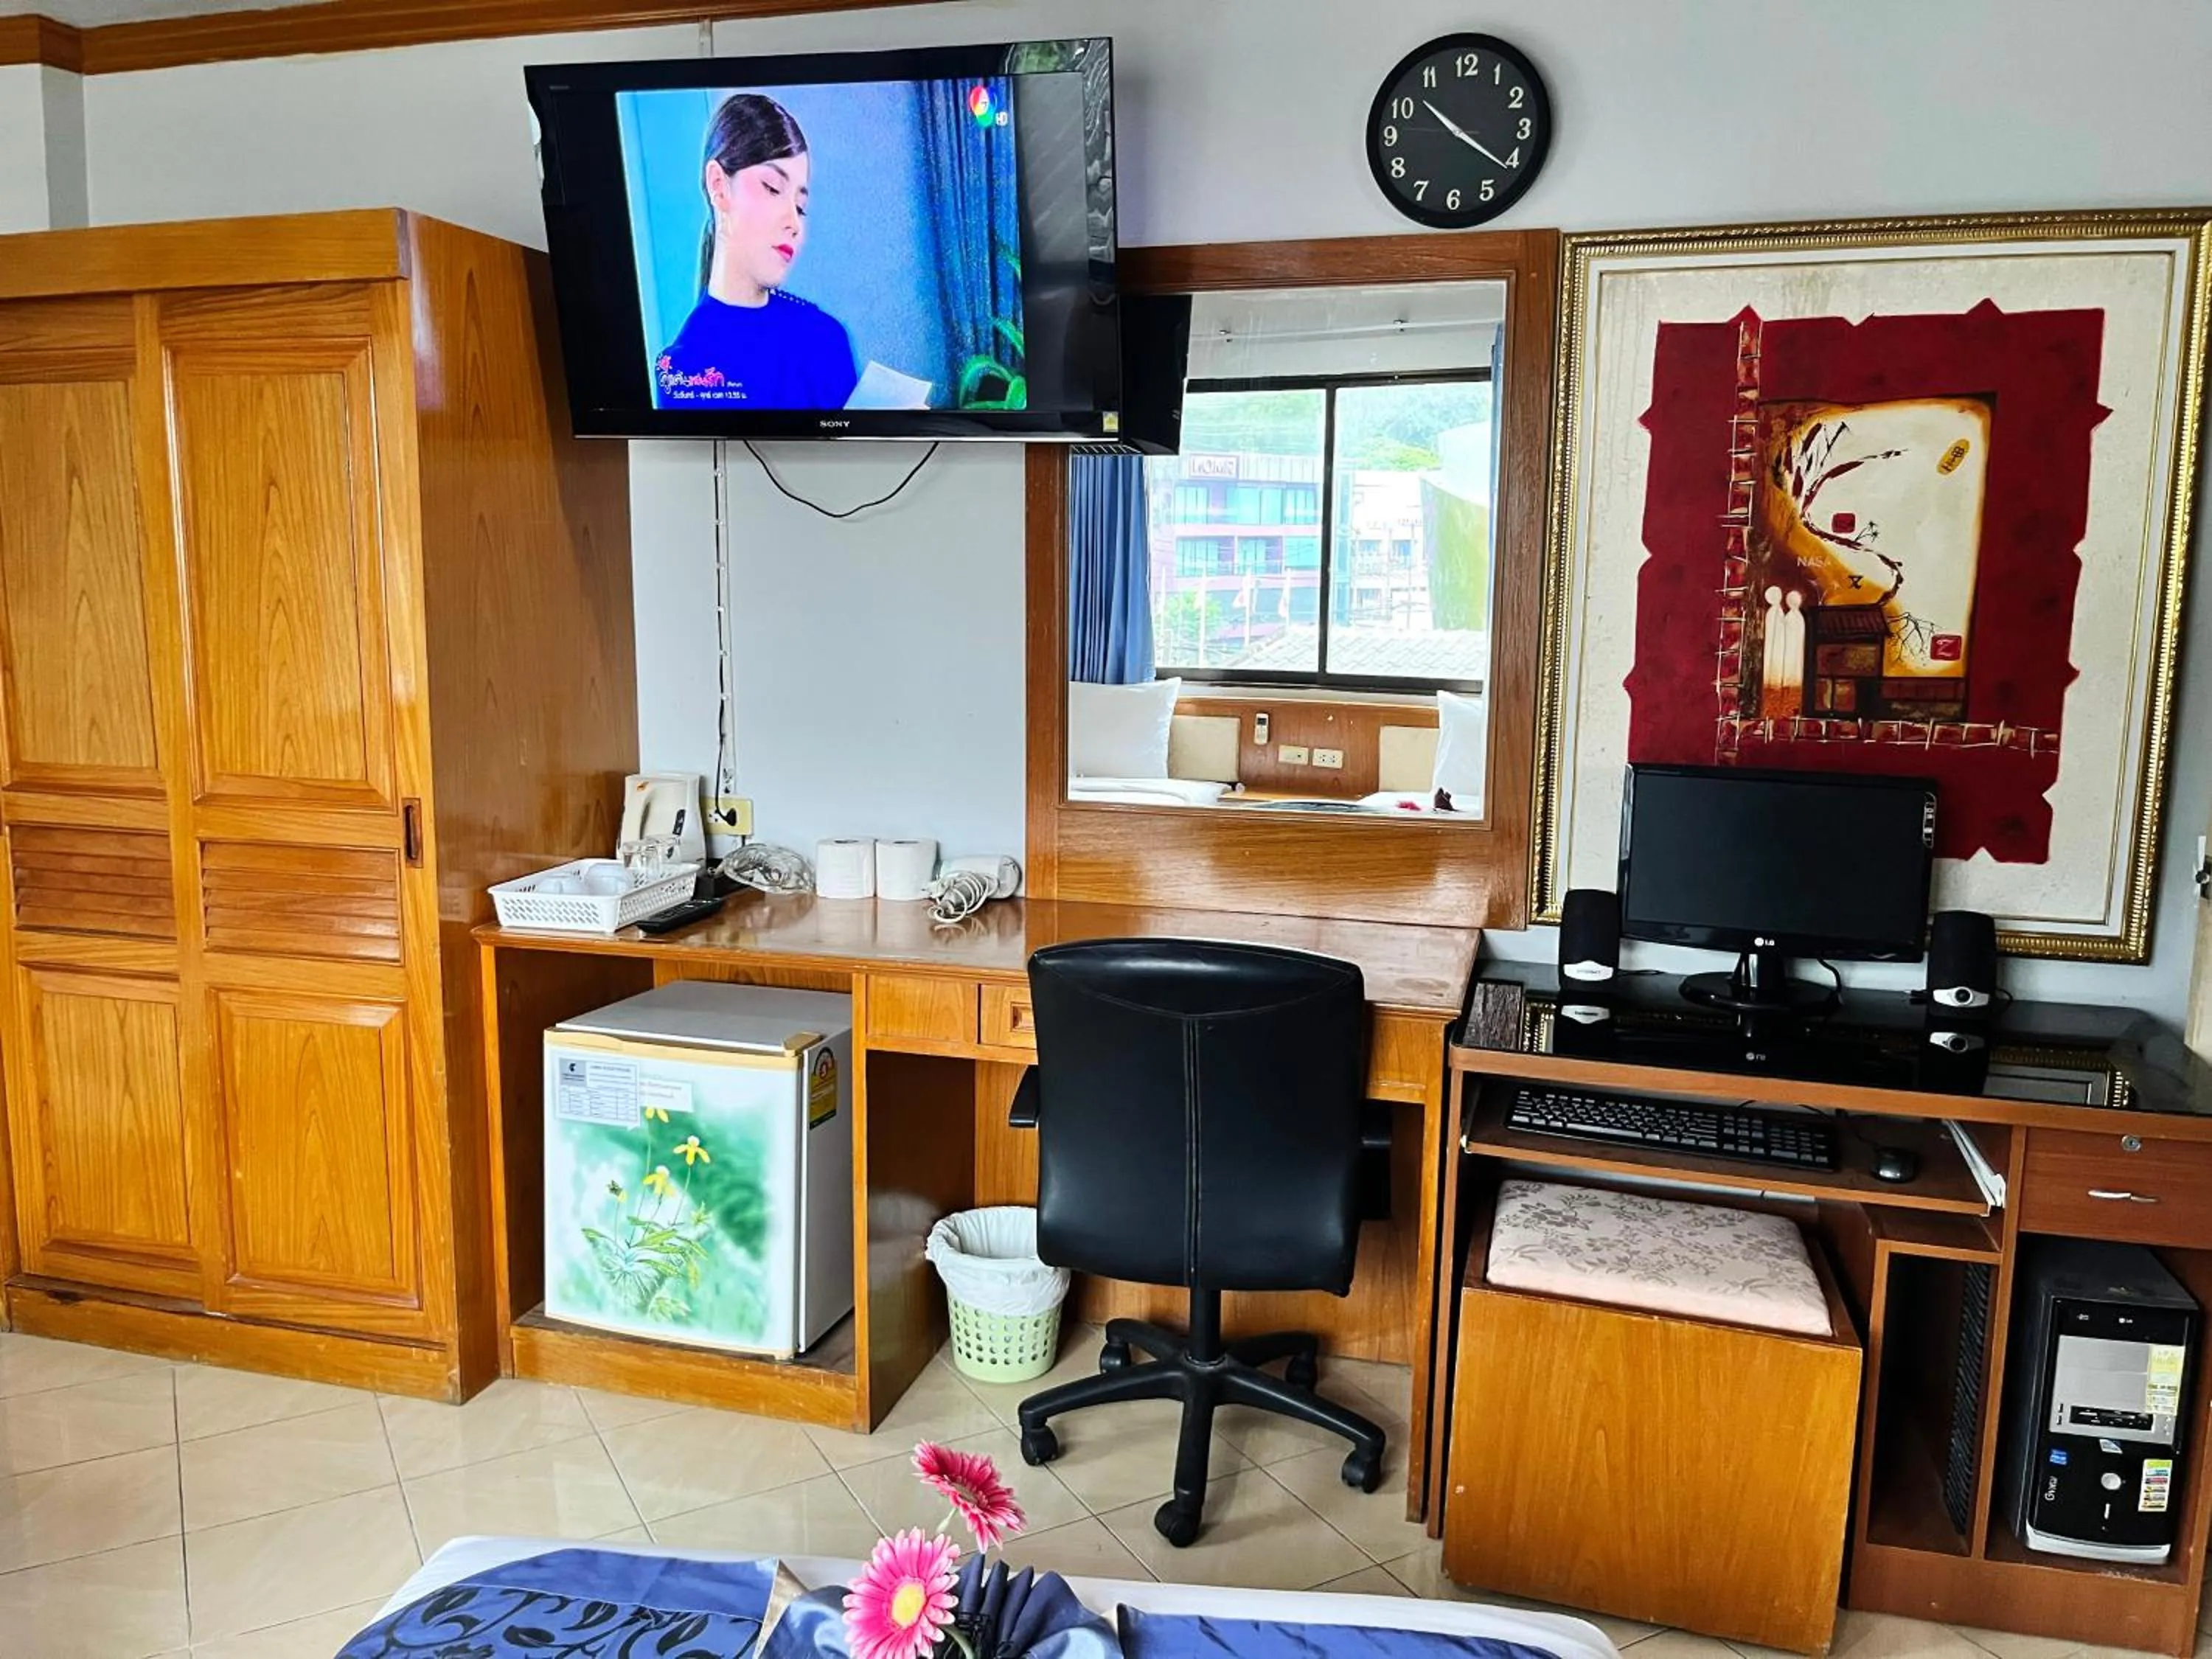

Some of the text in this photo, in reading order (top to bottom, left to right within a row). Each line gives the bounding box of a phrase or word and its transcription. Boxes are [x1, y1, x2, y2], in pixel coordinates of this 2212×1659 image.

[1455, 53, 1478, 77] 12
[1494, 63, 1501, 85] 1
[1423, 66, 1436, 88] 11
[1391, 97, 1413, 119] 10
[1508, 86, 1524, 108] 2
[1384, 125, 1398, 147] 9
[1517, 118, 1531, 139] 3
[1391, 157, 1405, 178] 8
[1505, 147, 1519, 168] 4
[1413, 180, 1429, 201] 7
[1446, 189, 1461, 210] 6
[1479, 179, 1495, 201] 5
